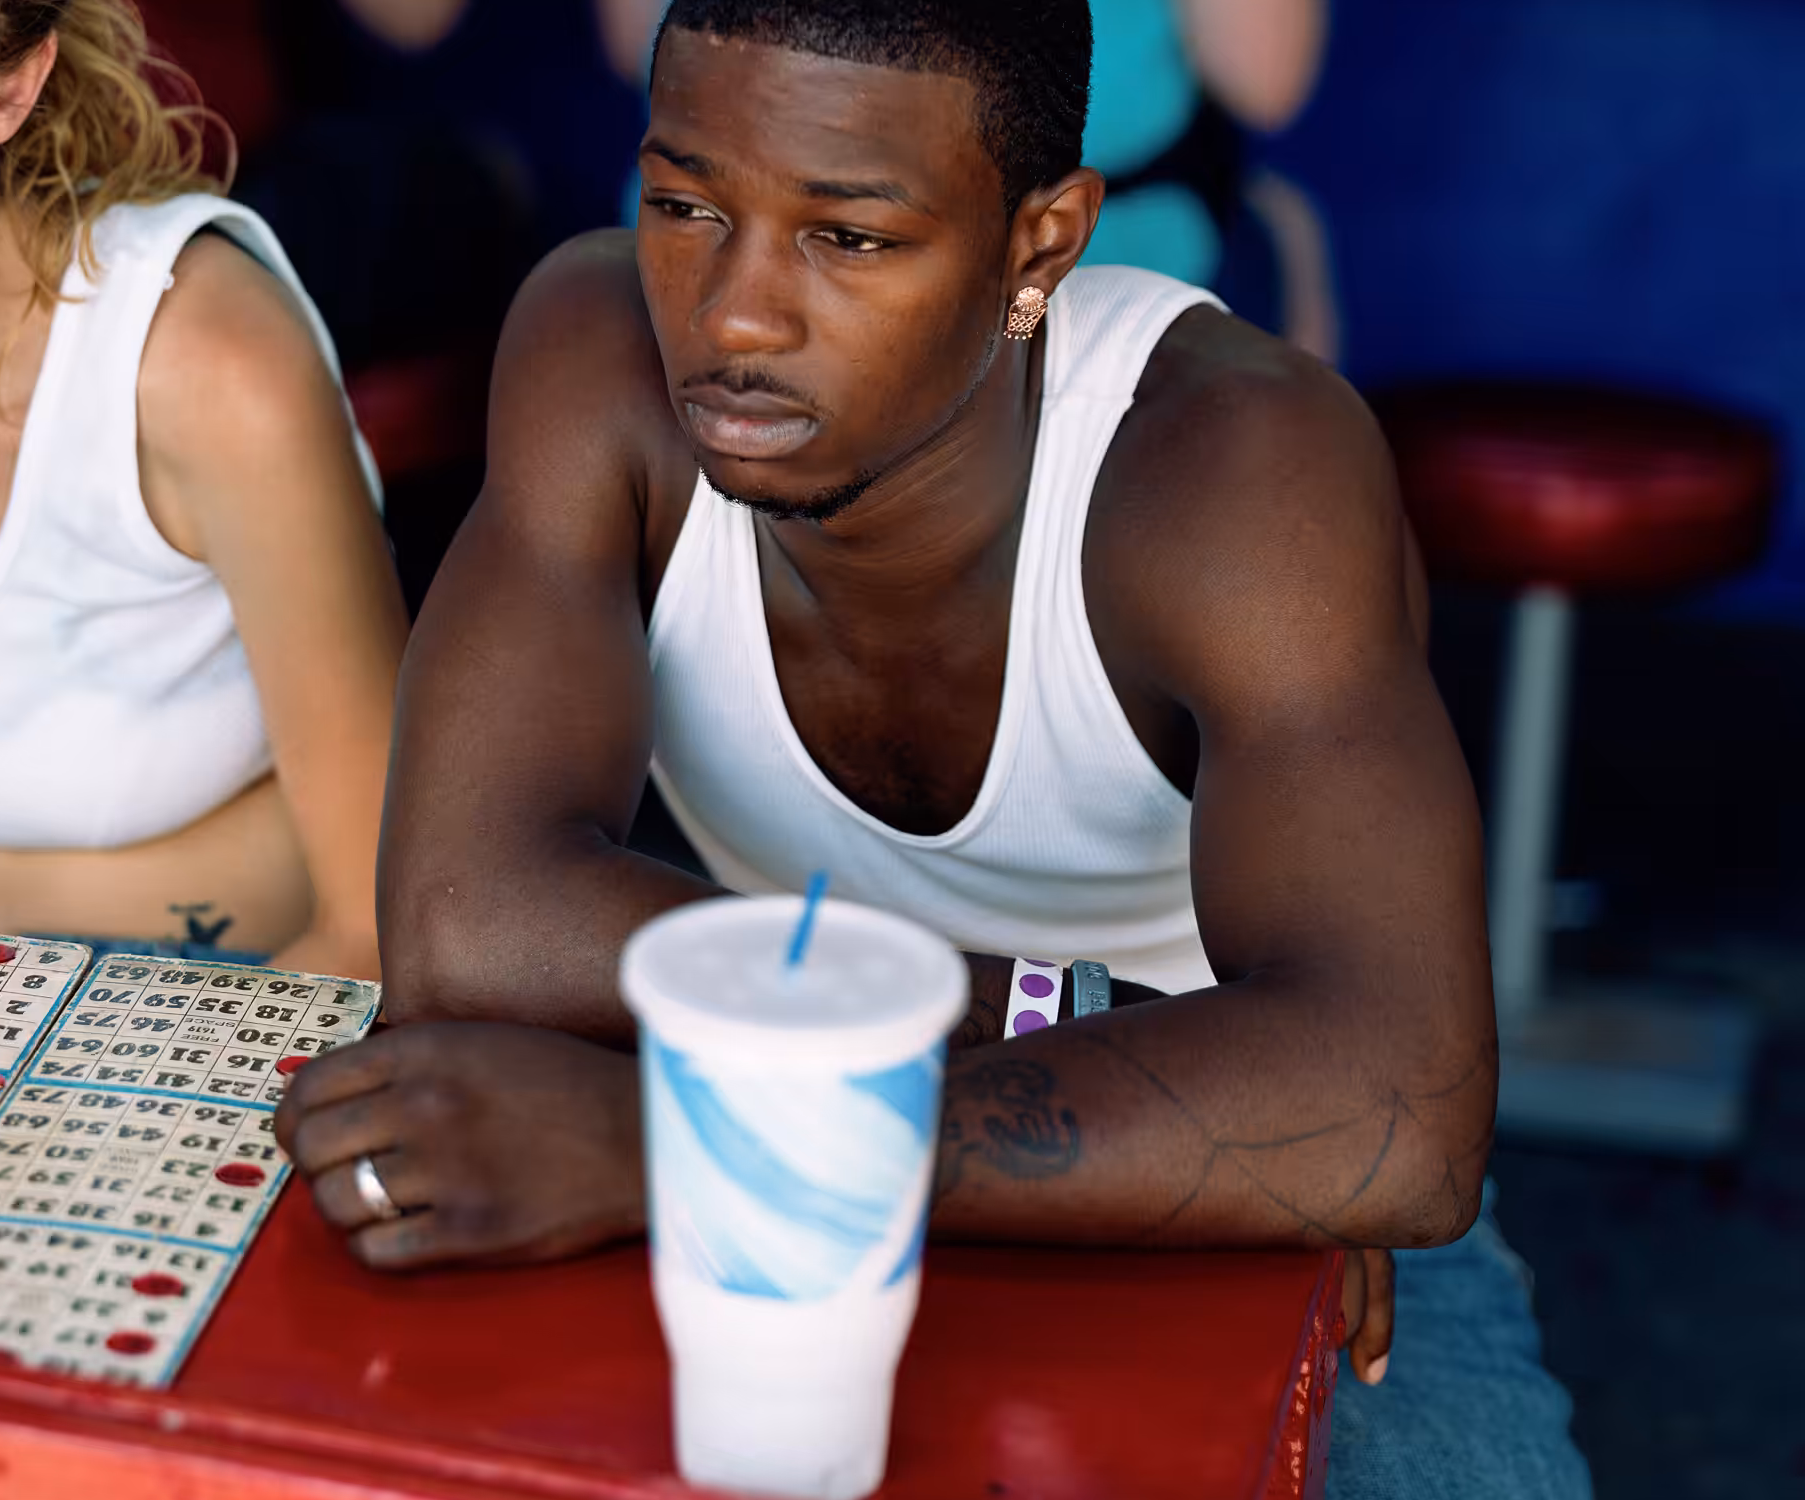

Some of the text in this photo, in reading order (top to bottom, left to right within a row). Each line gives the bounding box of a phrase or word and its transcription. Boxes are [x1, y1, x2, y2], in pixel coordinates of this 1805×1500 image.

[105, 965, 151, 980] 62
[20, 975, 48, 989] 8
[210, 975, 258, 992] 39
[267, 982, 316, 998] 26
[331, 990, 353, 1005] 1
[5, 1000, 33, 1015] 2
[89, 988, 340, 1027] 6 18 35 59 70
[74, 1013, 176, 1033] 46 75
[184, 1018, 237, 1028] SPACE
[180, 1034, 220, 1043] FREE
[236, 1029, 285, 1047] 30
[55, 1038, 271, 1072] 16 31 60 64
[40, 1062, 85, 1077] 74
[96, 1067, 144, 1083] 54
[154, 1072, 195, 1087] 41
[208, 1079, 258, 1097] 22
